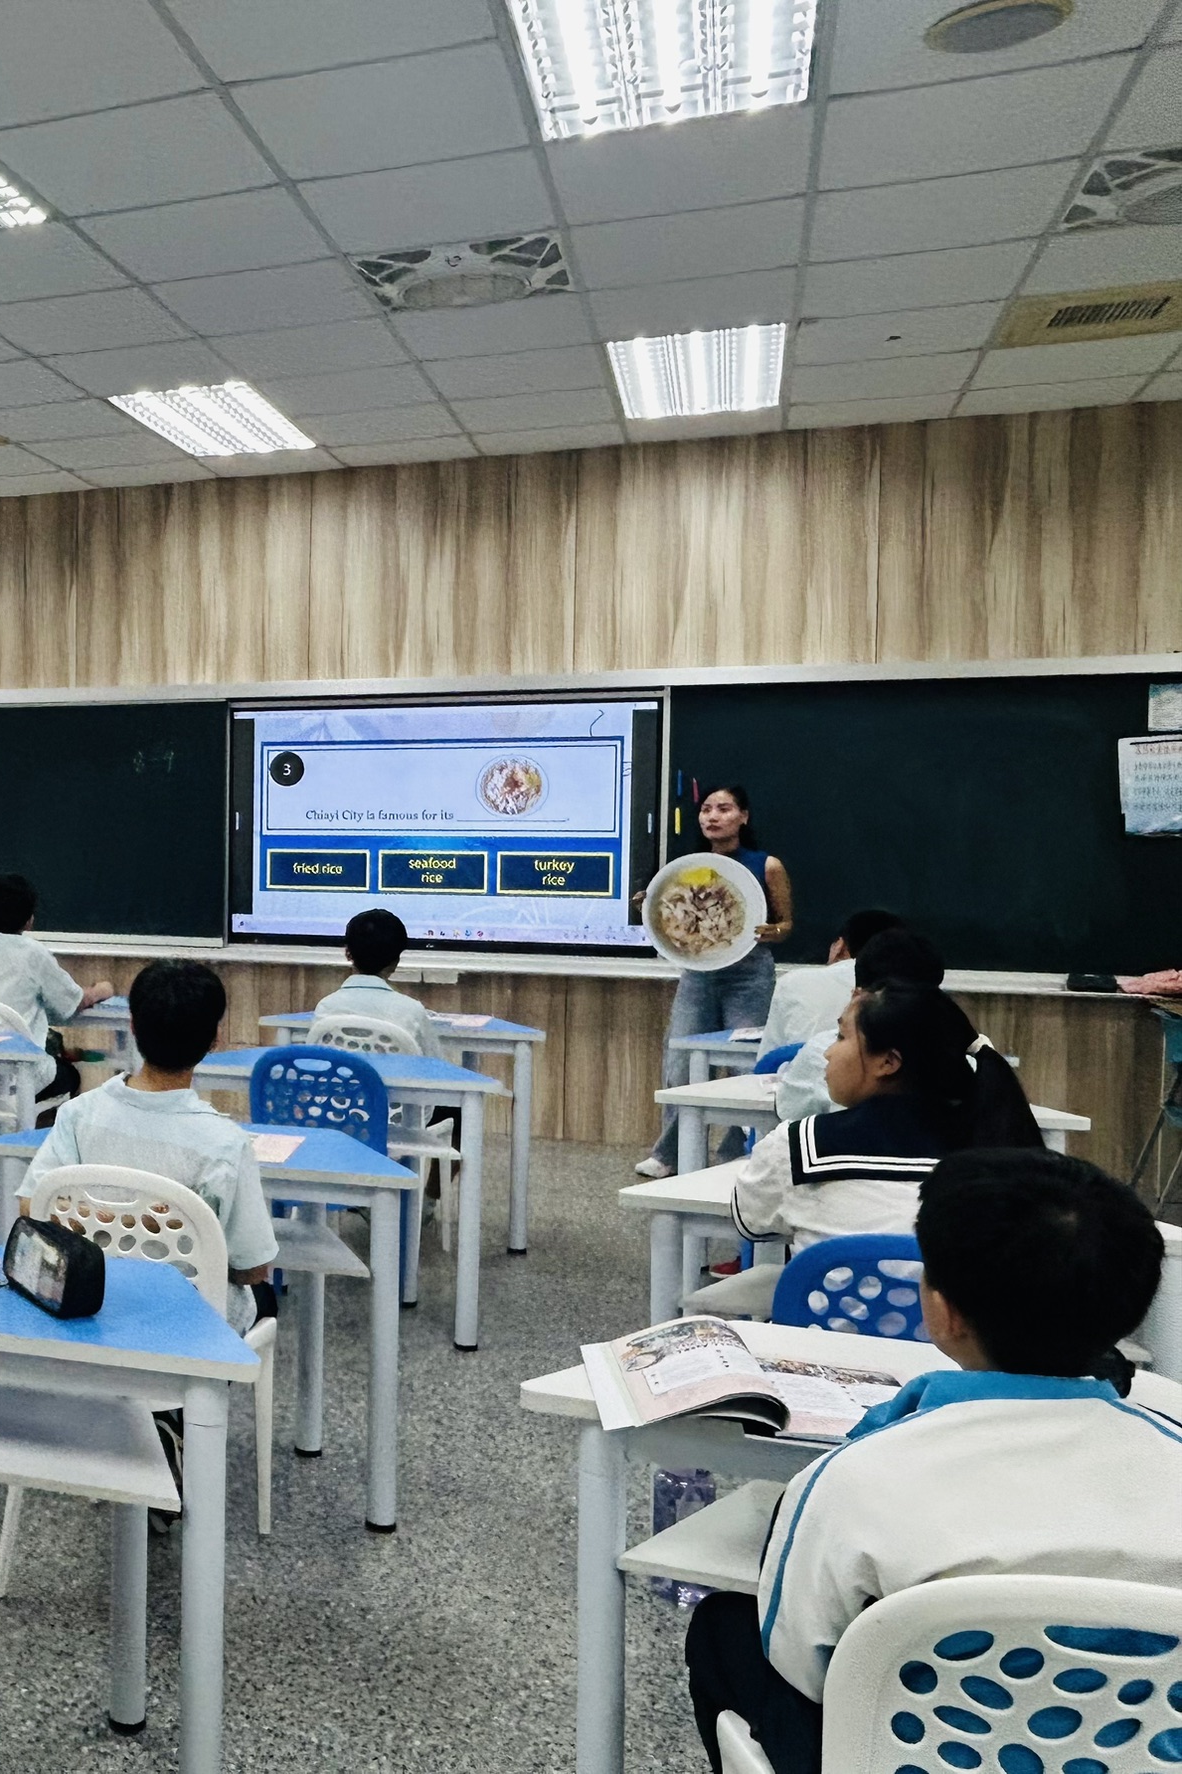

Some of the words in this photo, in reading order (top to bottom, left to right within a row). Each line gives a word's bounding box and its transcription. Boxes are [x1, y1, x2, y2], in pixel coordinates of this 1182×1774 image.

[283, 763, 291, 776] 3
[305, 810, 339, 822] Chiayi
[342, 810, 363, 822] City
[378, 810, 418, 820] famous
[421, 810, 437, 820] for
[440, 810, 454, 820] its
[292, 862, 319, 874] fried
[322, 863, 343, 874] rice
[408, 857, 457, 869] seafood
[534, 858, 576, 874] turkey
[421, 871, 443, 883] rice
[542, 873, 566, 886] rice
